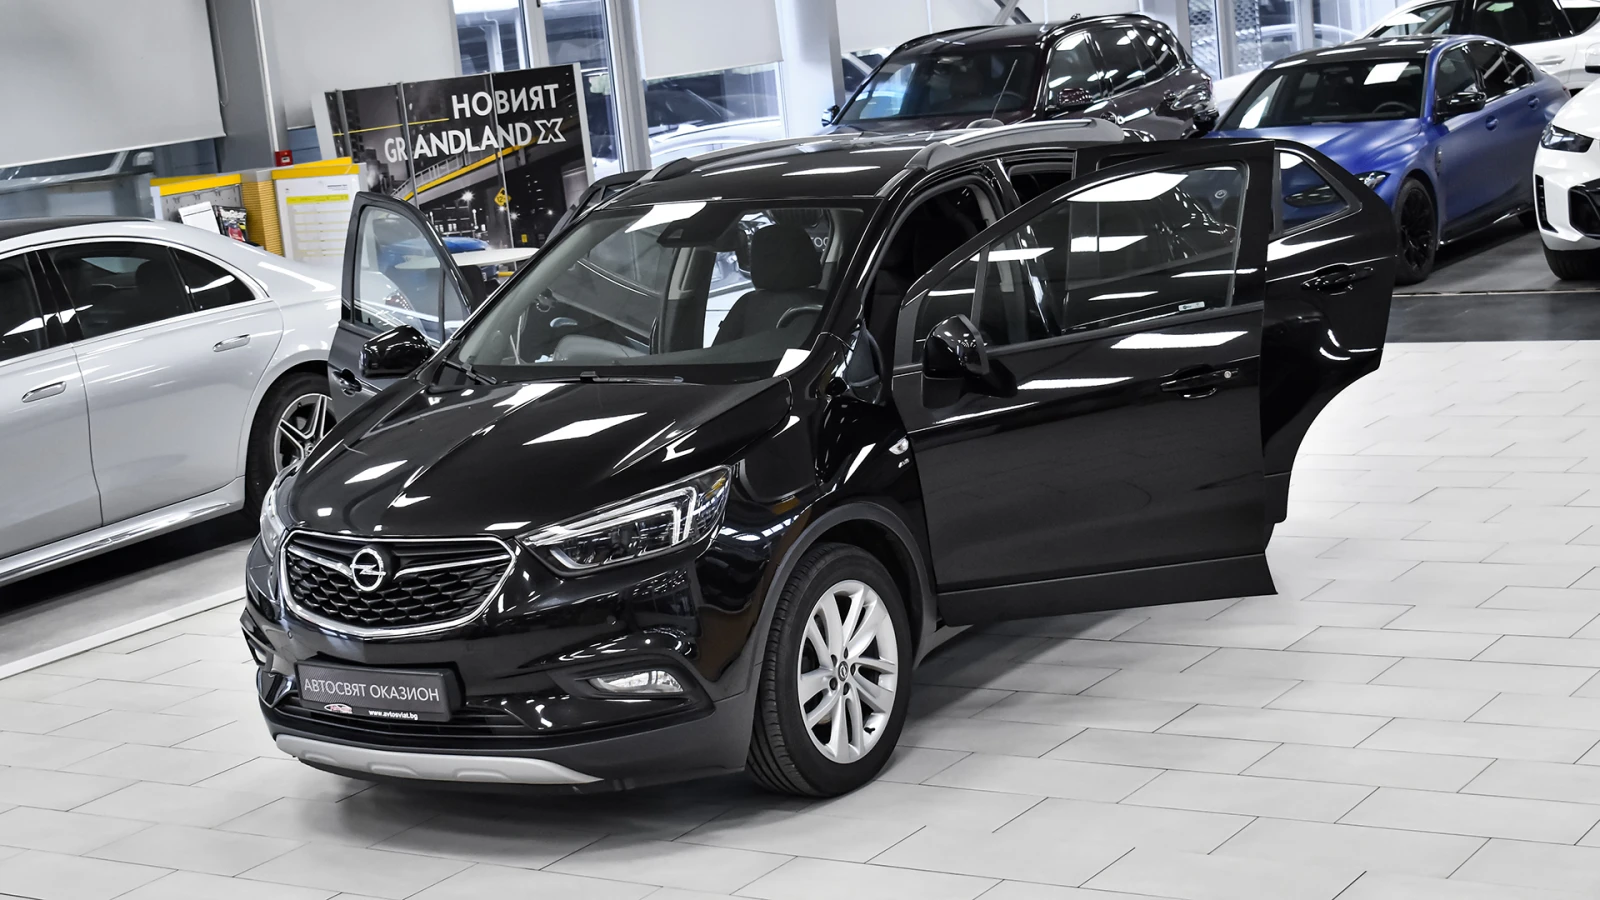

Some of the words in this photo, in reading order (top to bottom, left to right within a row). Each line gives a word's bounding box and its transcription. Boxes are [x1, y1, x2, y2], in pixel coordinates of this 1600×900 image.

[452, 84, 559, 120] НОВИЯТ
[304, 678, 367, 697] АВТОСВЯТ
[369, 685, 441, 702] ОКАЗИОН
[368, 710, 419, 721] www.avtosviat.bg
